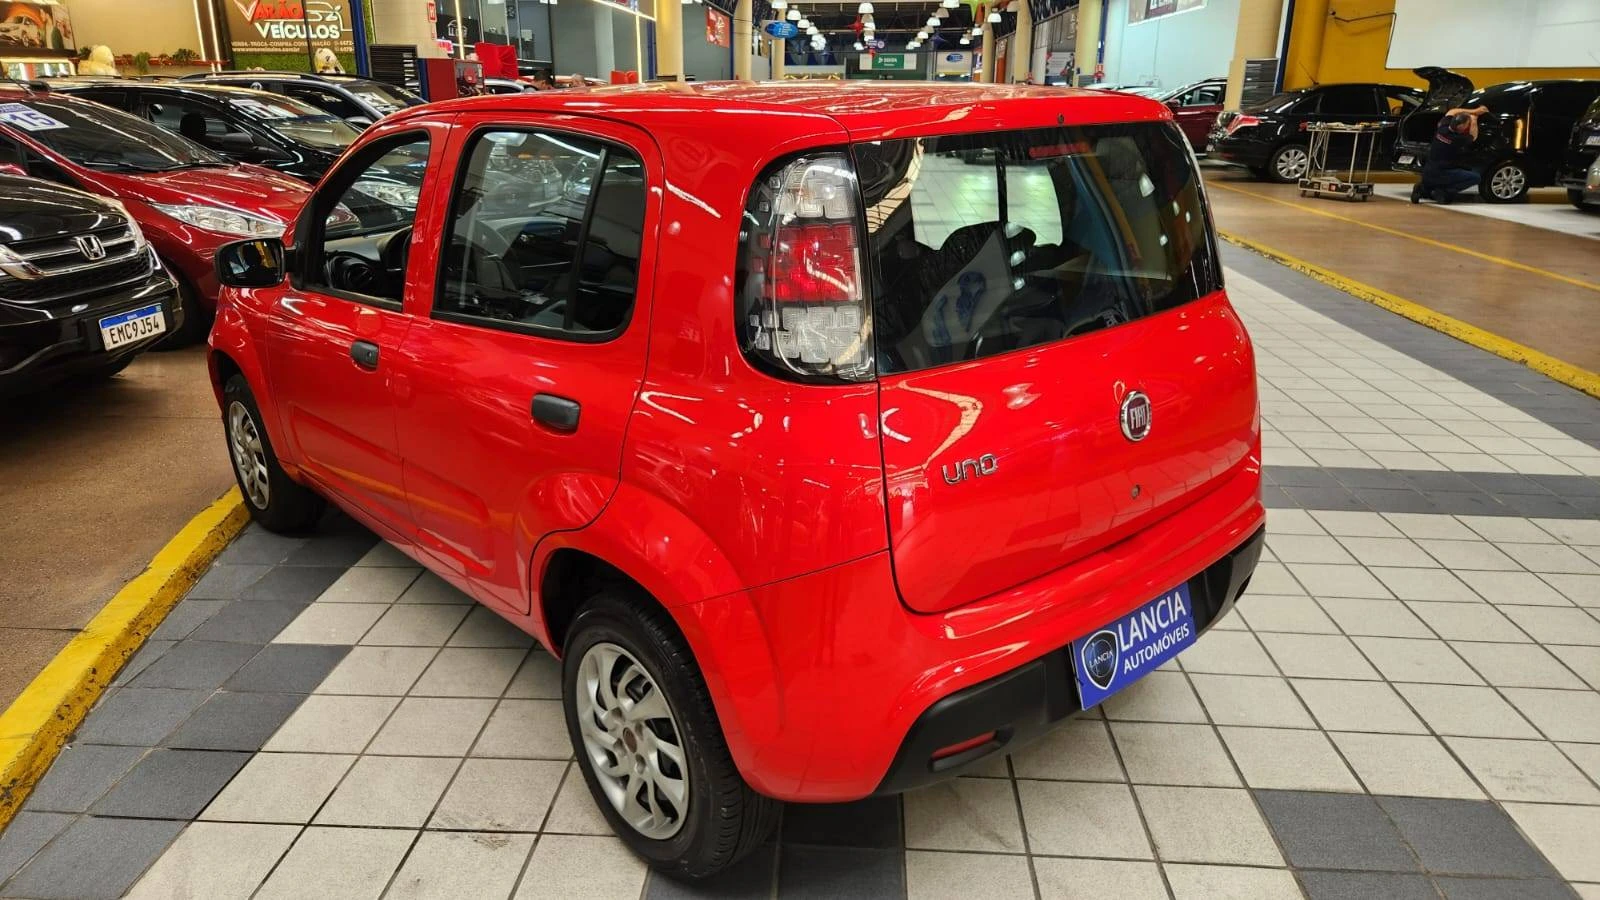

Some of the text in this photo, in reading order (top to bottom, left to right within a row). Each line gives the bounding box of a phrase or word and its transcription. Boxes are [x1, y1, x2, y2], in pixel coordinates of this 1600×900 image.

[254, 21, 340, 38] VEÍCULOS
[9, 112, 56, 127] 15
[109, 315, 160, 345] EMC9J54
[1130, 405, 1146, 429] FIAT
[1118, 591, 1187, 652] LANCIA
[1089, 650, 1114, 668] LANCIA
[1123, 622, 1190, 675] AUTOMÓVEIS
